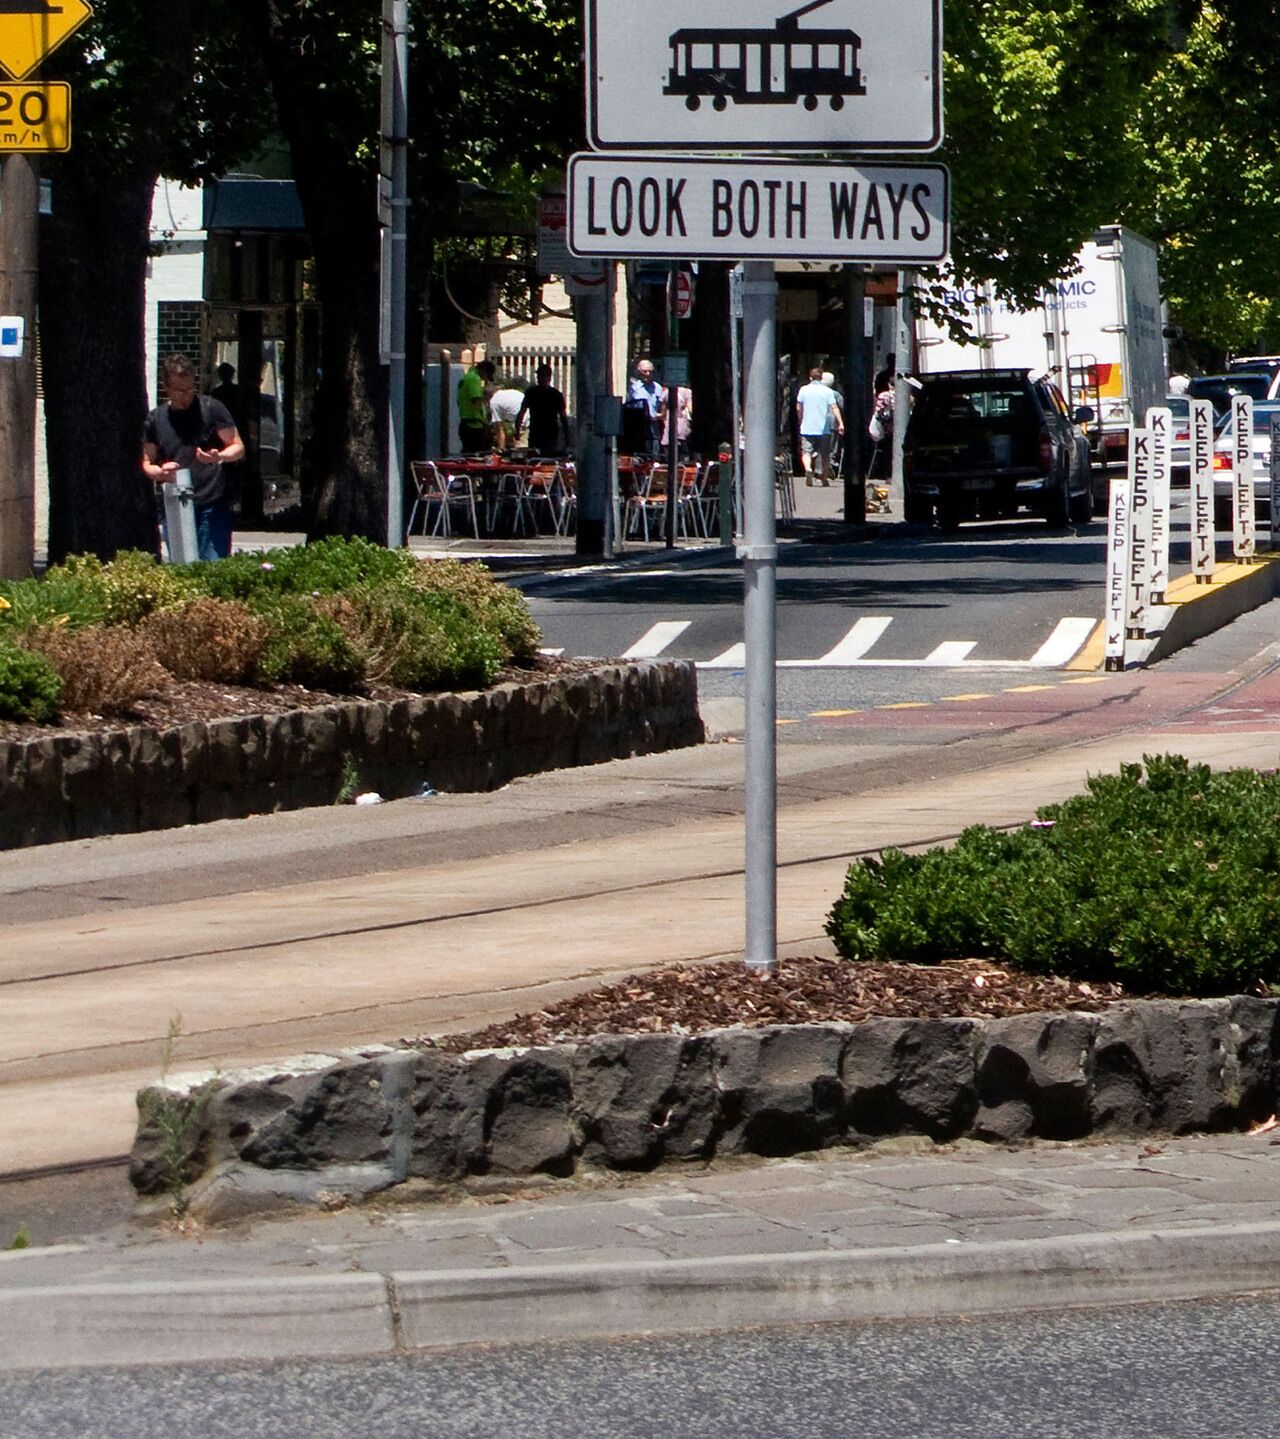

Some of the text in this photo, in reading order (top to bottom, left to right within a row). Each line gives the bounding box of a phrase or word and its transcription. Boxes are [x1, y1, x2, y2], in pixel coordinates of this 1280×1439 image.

[0, 129, 41, 145] m/h
[587, 176, 932, 242] LOOK BOTH WAYS
[1131, 436, 1149, 601] KEEP LEFT
[1195, 407, 1209, 551] KEEP LEFT
[1236, 402, 1250, 535] KEEP LEFT
[1111, 493, 1126, 621] KEEP LEFT
